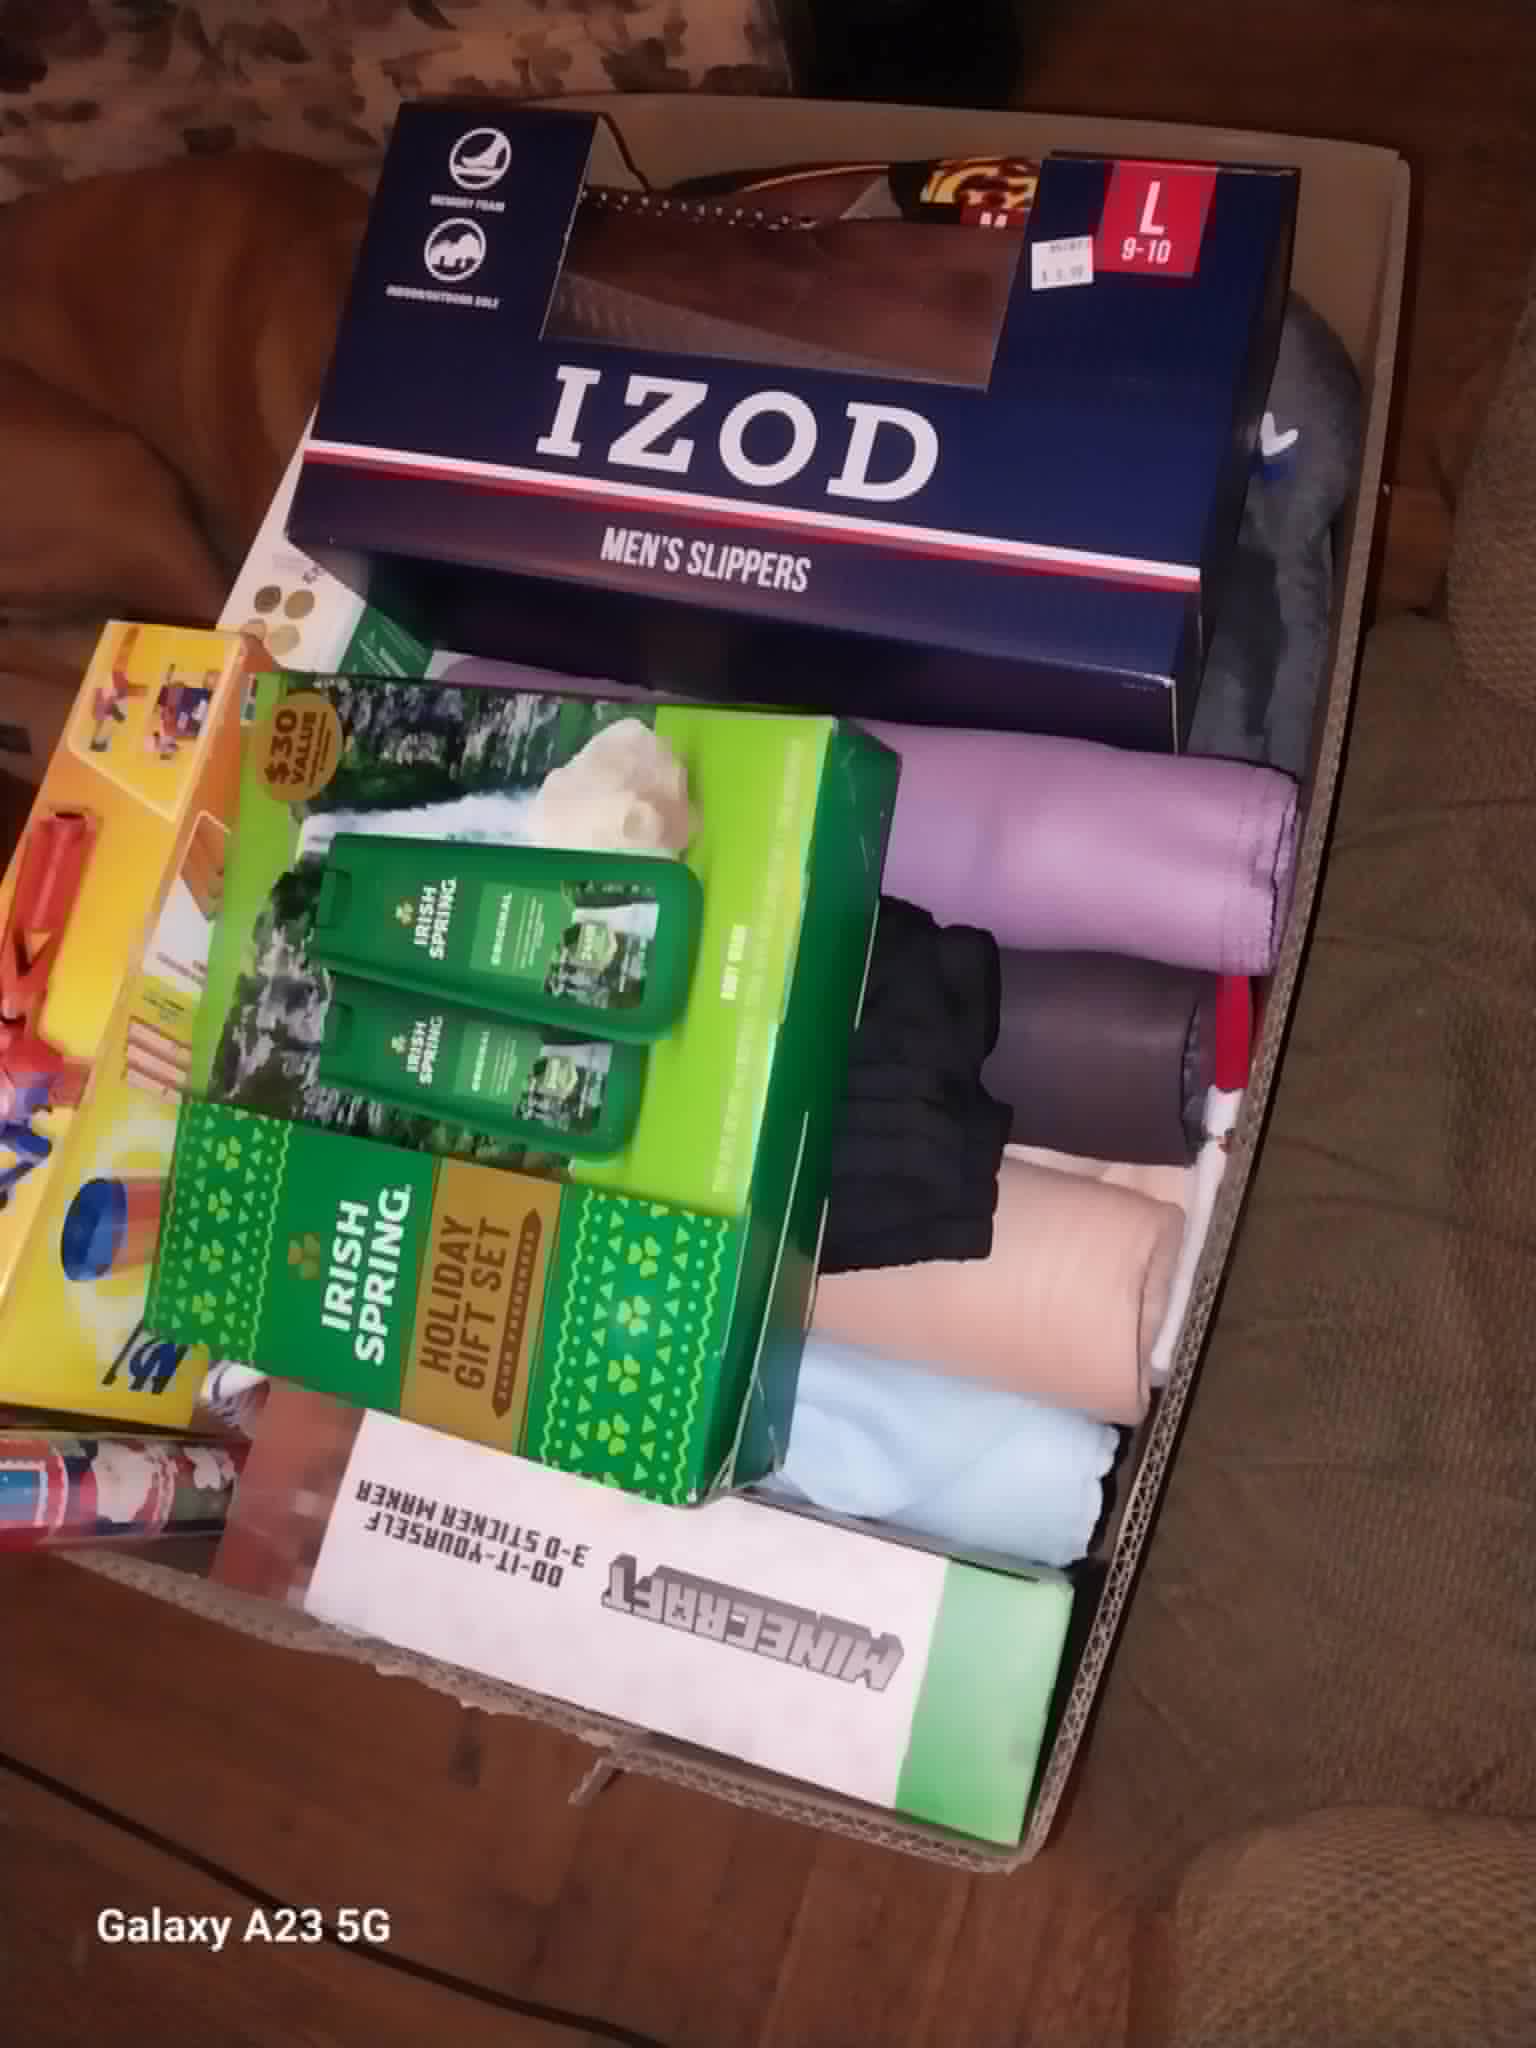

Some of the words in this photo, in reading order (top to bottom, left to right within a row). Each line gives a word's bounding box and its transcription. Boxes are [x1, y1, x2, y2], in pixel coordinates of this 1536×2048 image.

[1139, 181, 1165, 235] L
[1121, 237, 1172, 265] 9-10
[535, 364, 939, 502] IZOD
[601, 527, 685, 572] MEN'S
[687, 541, 812, 593] SLIPPERS
[264, 709, 298, 785] $30
[414, 884, 437, 945] IRISH
[429, 877, 457, 960] SPRING
[320, 1199, 369, 1332] IRISH
[353, 1185, 412, 1367] SPRING
[471, 1217, 511, 1292] SET
[419, 1215, 473, 1374] HOLIDAY
[454, 1302, 496, 1390] GIFT
[355, 1479, 438, 1521] MAKER
[440, 1505, 541, 1552] STICKER
[364, 1510, 564, 1588] DO-IT-YOURSELF
[601, 1552, 905, 1692] MINECRAFT
